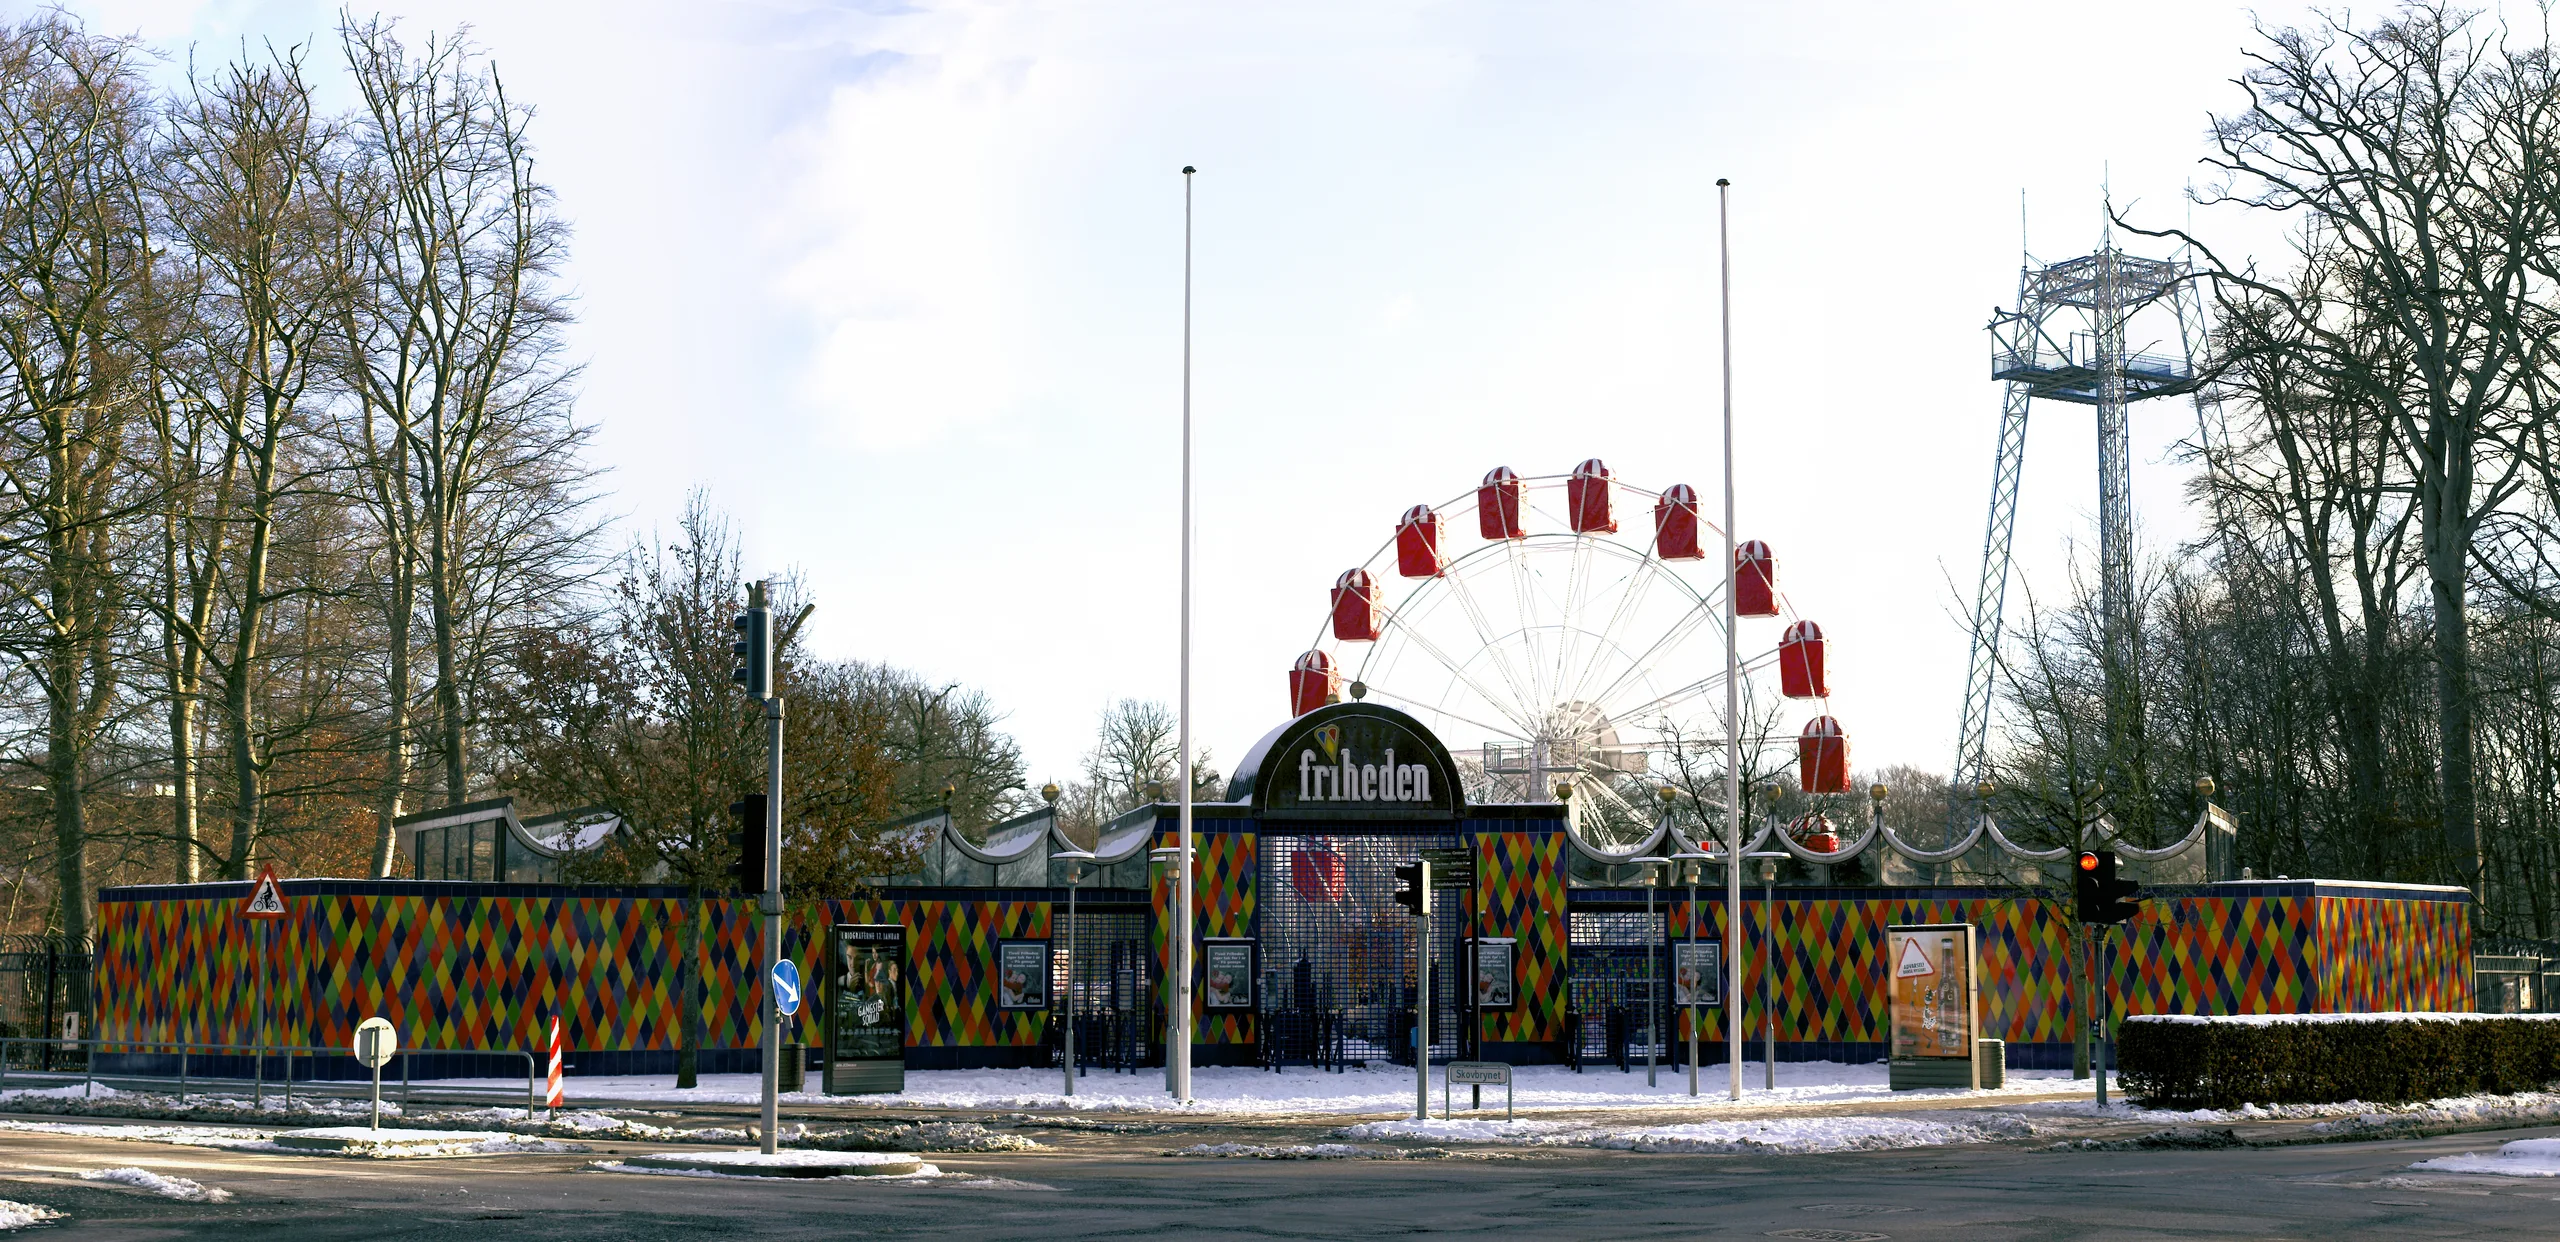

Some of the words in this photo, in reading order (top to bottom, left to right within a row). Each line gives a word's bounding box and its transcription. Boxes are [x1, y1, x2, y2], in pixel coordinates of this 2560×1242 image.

[1299, 748, 1432, 801] friheden
[858, 1002, 884, 1016] GANGSTER
[862, 1012, 879, 1026] SQUAD
[1456, 1070, 1501, 1082] Skovbrynet
